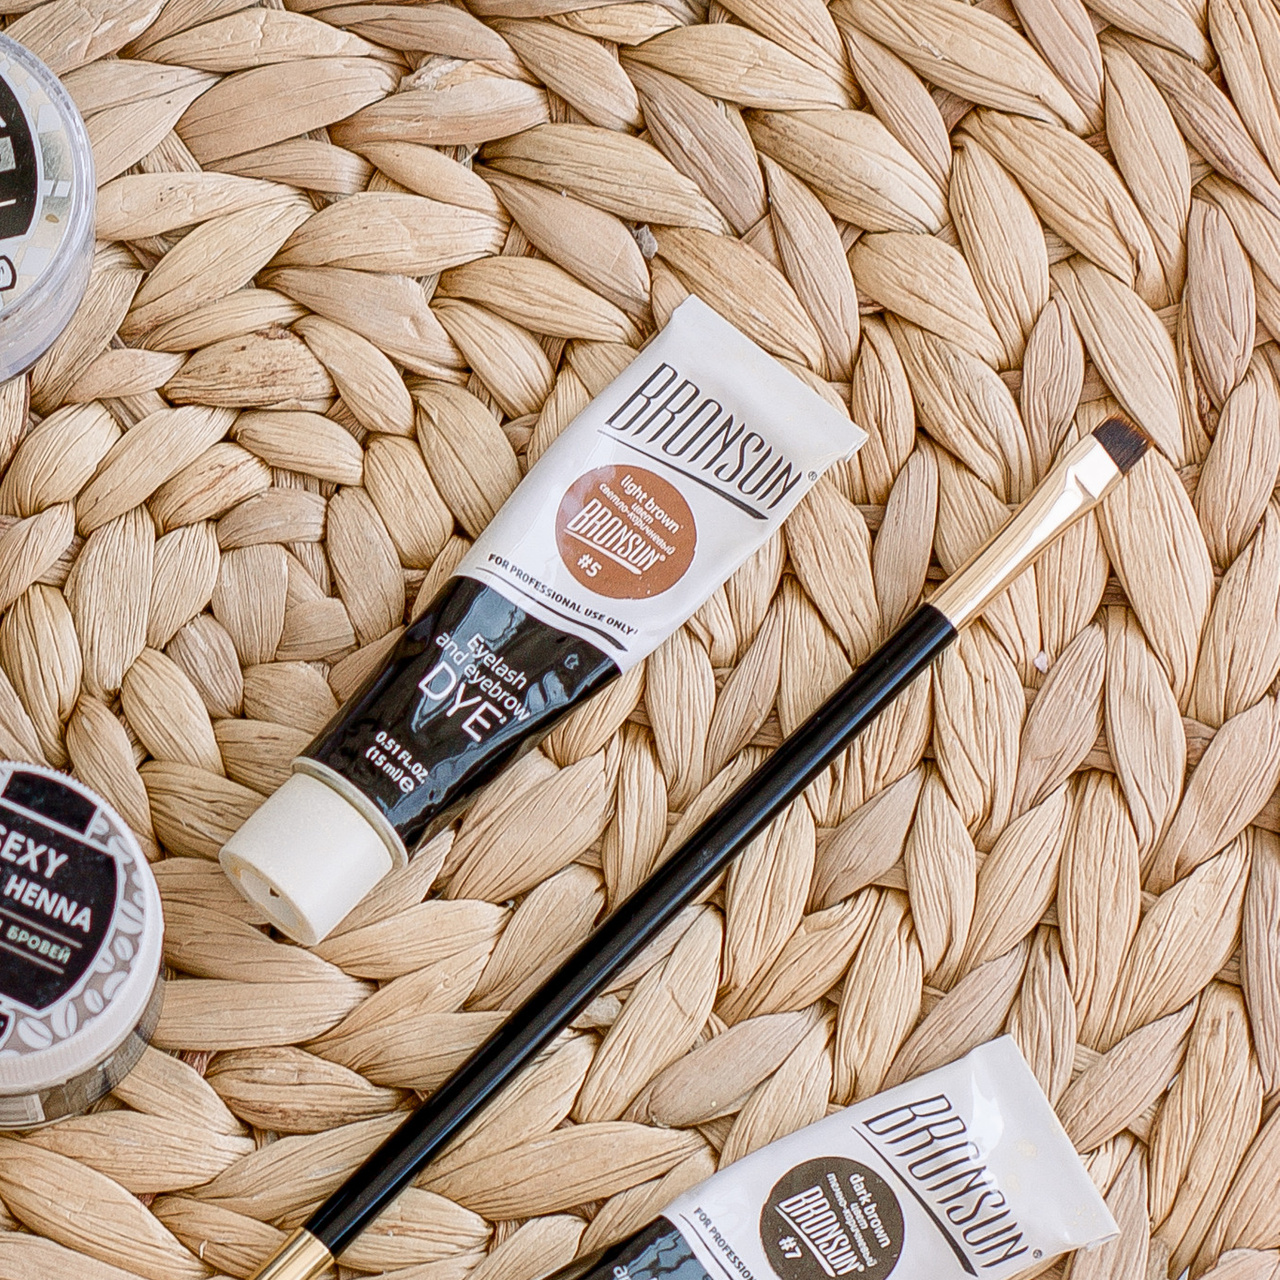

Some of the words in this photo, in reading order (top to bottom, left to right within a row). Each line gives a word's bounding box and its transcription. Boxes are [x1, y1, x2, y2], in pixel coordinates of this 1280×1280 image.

[604, 362, 802, 511] BRONSUN
[599, 483, 676, 555] светло-коричневый
[621, 474, 648, 503] light
[644, 497, 680, 534] brown
[631, 502, 654, 525] цвет
[566, 498, 661, 571] BRONSUN
[488, 553, 510, 571] FOR
[508, 564, 584, 615] PROFESSIONAL
[583, 608, 607, 622] USE
[577, 553, 603, 578] #5
[435, 631, 470, 666] and
[464, 664, 532, 721] eyebrow
[467, 632, 528, 691] Eyelash
[365, 747, 384, 768] (15
[375, 730, 399, 756] 0.51
[3, 873, 92, 933] HENNA
[6, 925, 72, 964] БРОВЕЙ
[849, 1173, 872, 1206] dark
[864, 1203, 891, 1248] brown
[862, 1094, 1029, 1268] BRONSUN
[694, 1208, 712, 1229] FOR
[779, 1185, 860, 1275] BRONSUN
[779, 1236, 802, 1259] #7
